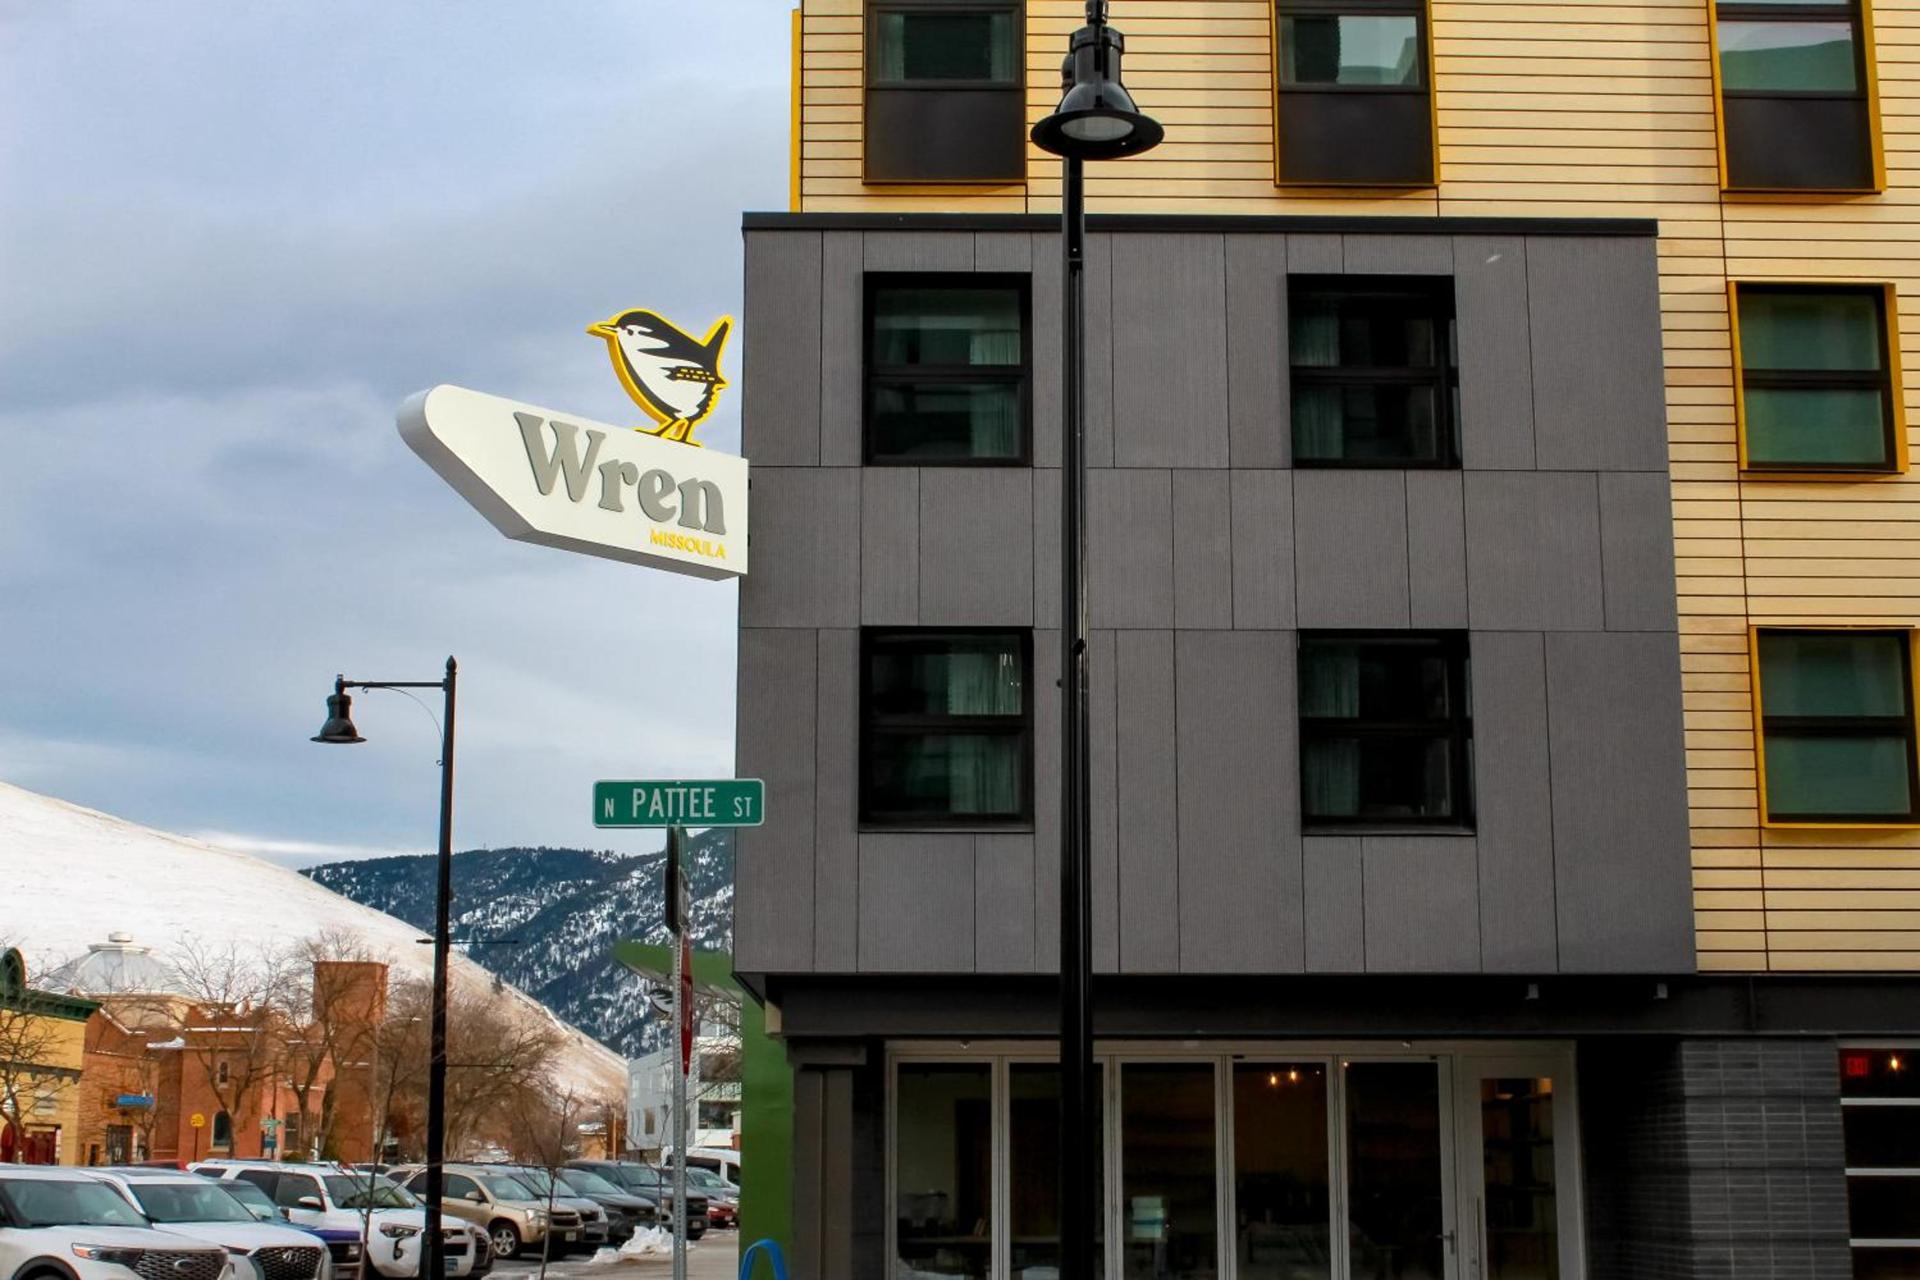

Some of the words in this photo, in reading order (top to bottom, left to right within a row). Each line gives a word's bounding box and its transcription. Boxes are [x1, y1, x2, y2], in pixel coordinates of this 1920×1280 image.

[513, 411, 727, 536] Wren
[650, 529, 727, 559] MISSOULA
[605, 798, 615, 818] N
[632, 788, 716, 818] PATTEE
[734, 797, 753, 817] ST
